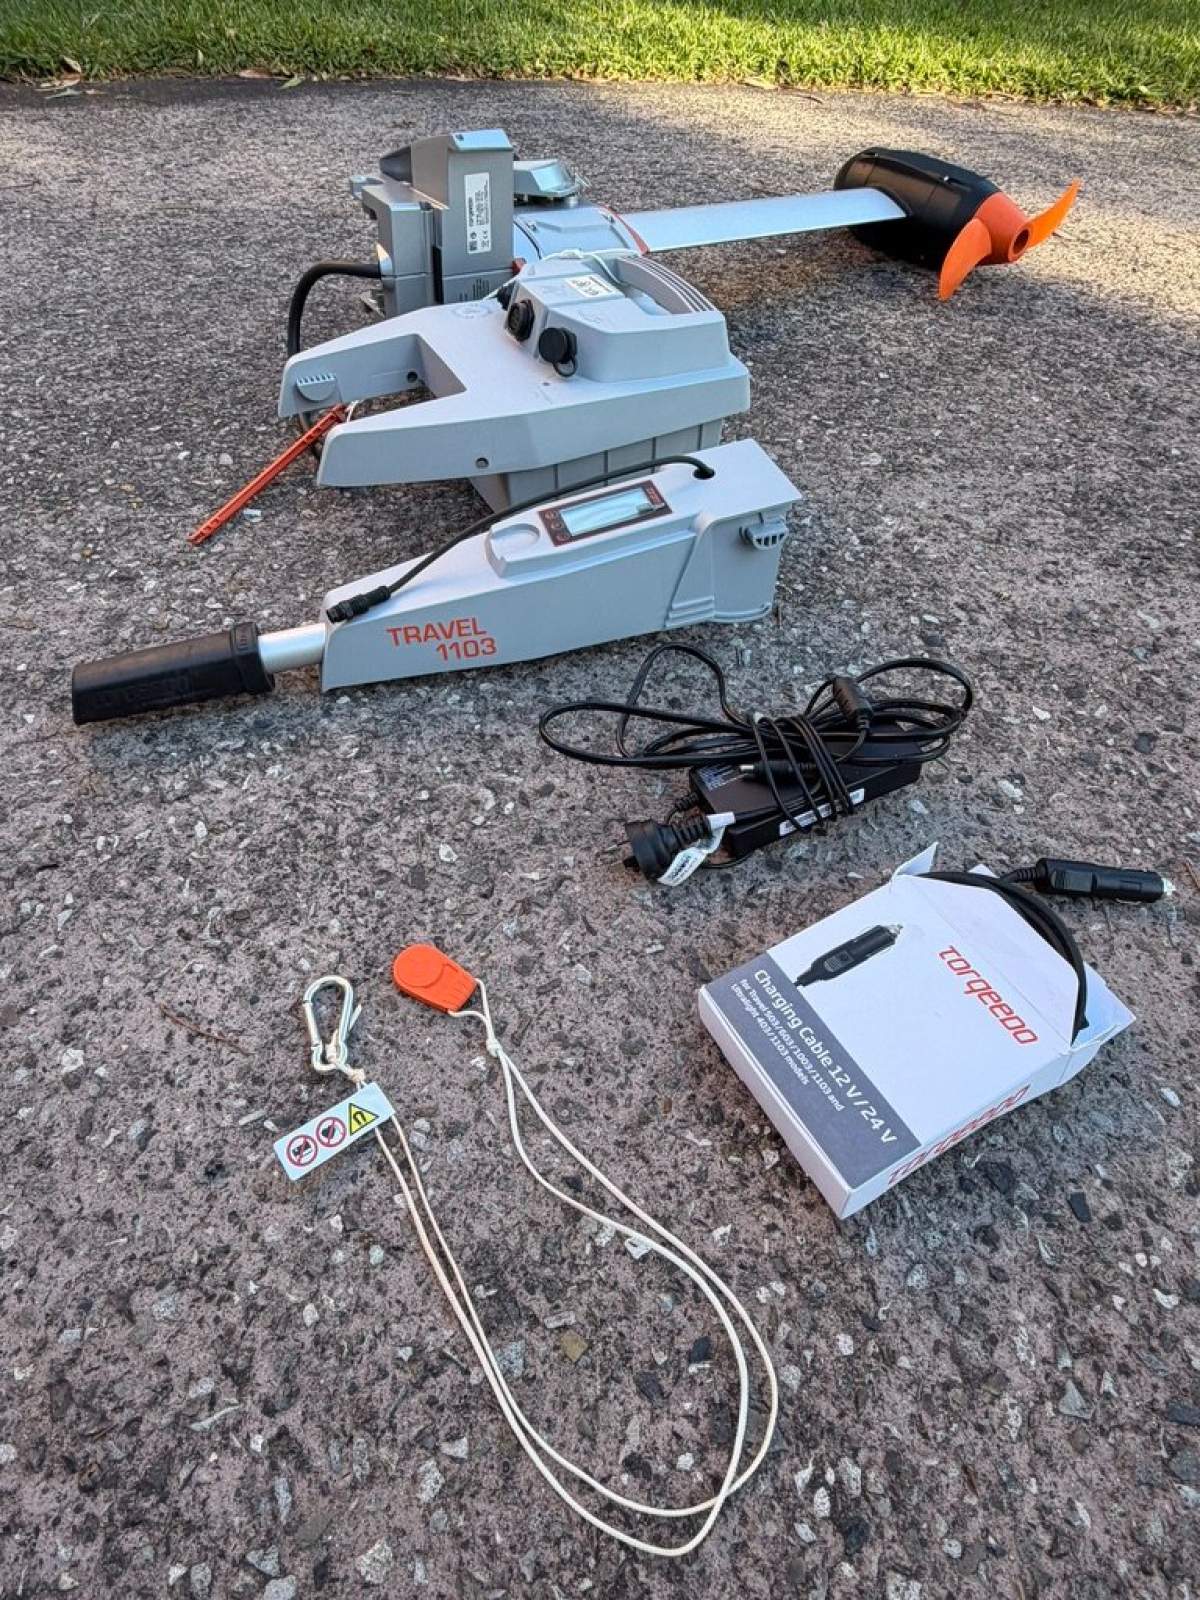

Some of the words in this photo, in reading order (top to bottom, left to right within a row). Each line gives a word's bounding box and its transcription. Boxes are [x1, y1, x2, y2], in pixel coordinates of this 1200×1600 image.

[385, 617, 487, 647] TRAVEL
[436, 637, 497, 662] 1103
[754, 969, 803, 1029] Charging
[799, 1027, 833, 1067] Cable
[828, 1065, 851, 1088] 12
[880, 1128, 898, 1143] V
[784, 1055, 810, 1086] models
[827, 1094, 846, 1112] and
